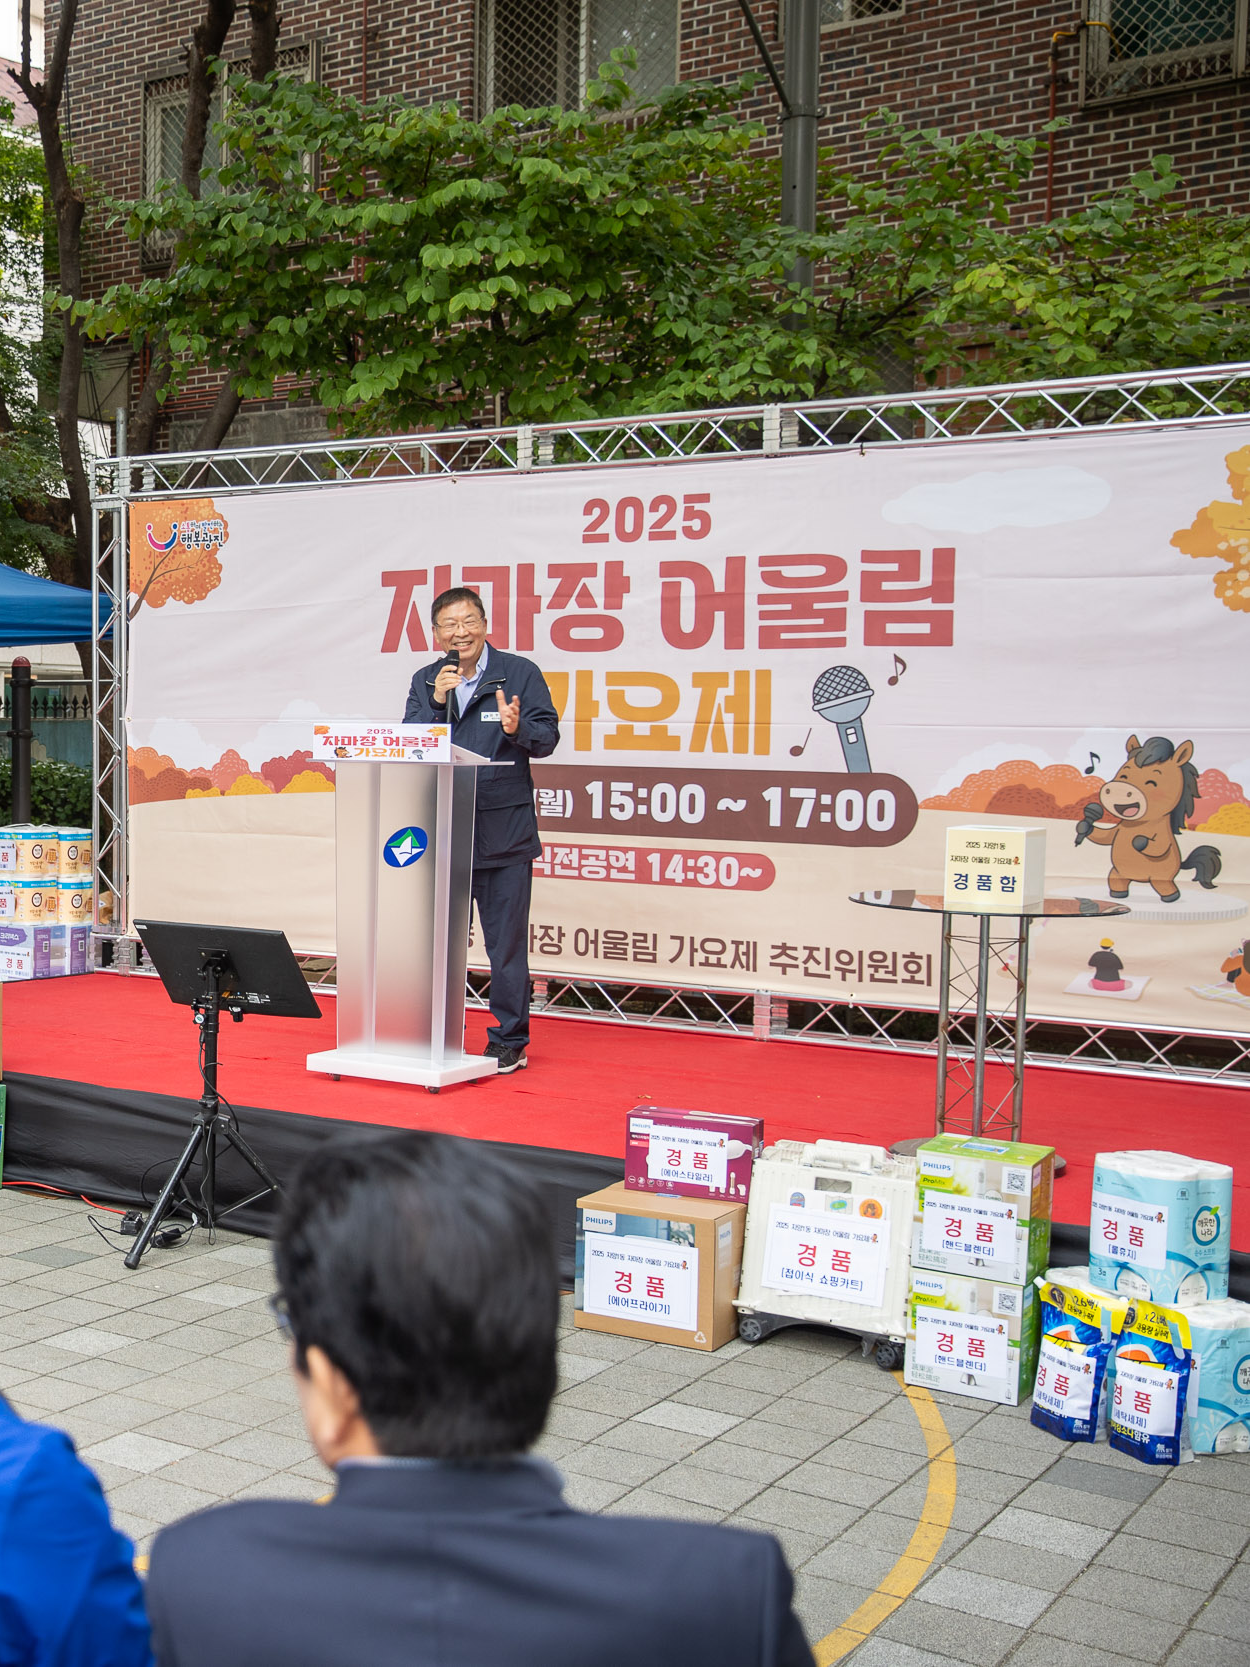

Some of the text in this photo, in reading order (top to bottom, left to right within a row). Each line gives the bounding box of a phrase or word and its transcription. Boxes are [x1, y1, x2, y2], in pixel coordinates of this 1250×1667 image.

[582, 493, 712, 544] 2025
[181, 531, 223, 549] 행복광진
[659, 547, 956, 650] 어울림
[542, 669, 772, 755] 가요제
[323, 736, 439, 748] 자마장 어울림
[354, 747, 405, 758] 가요제
[585, 781, 706, 824] 15:00
[761, 787, 896, 831] 17:00
[965, 841, 981, 849] 2025
[950, 855, 1012, 865] 자마장 어울림 가요제
[647, 854, 763, 887] 14:30~
[574, 927, 658, 964] 어울림
[669, 934, 758, 973] 가요제
[769, 942, 932, 987] 추진위원회
[923, 1161, 951, 1171] PHILIPS
[585, 1216, 613, 1226] PHILIPS
[781, 1267, 863, 1292] [접이식 쇼핑카트]
[915, 1279, 943, 1290] PHILIPS
[608, 1295, 671, 1315] [에어프라이기]
